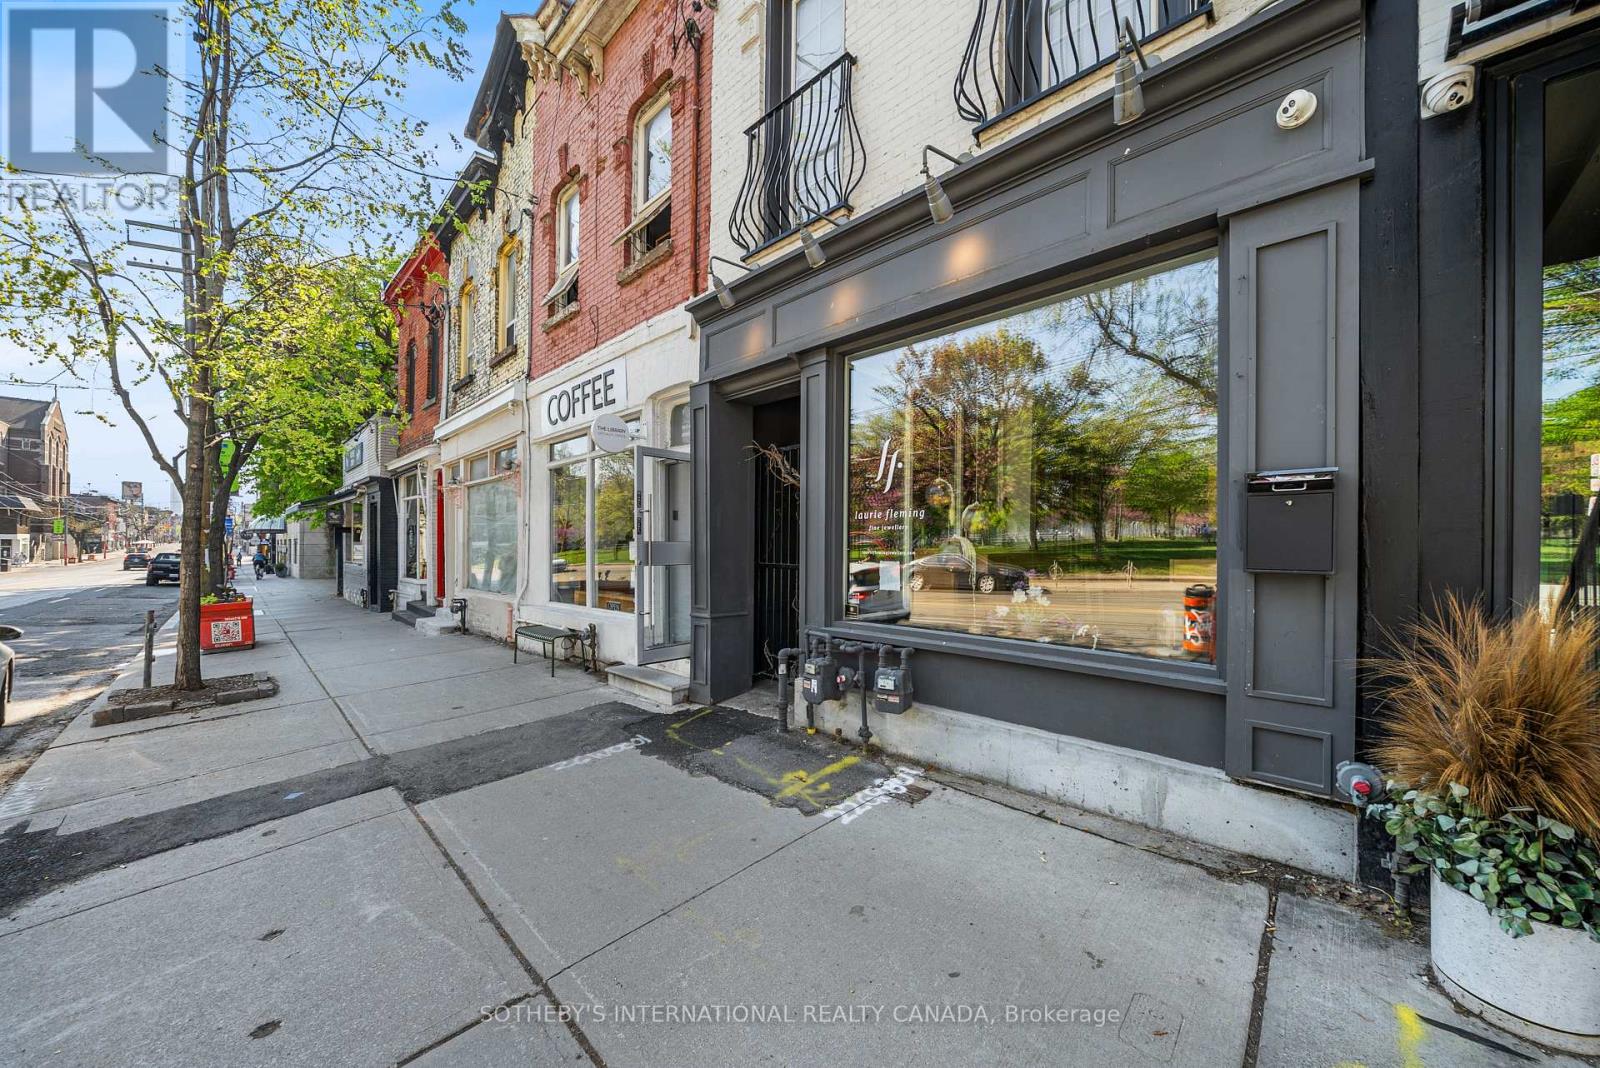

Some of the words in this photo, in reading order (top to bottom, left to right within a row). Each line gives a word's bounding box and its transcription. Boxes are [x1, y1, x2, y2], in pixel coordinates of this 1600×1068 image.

[548, 369, 616, 425] COFFEE
[854, 510, 882, 520] laurie
[885, 508, 926, 521] fleming
